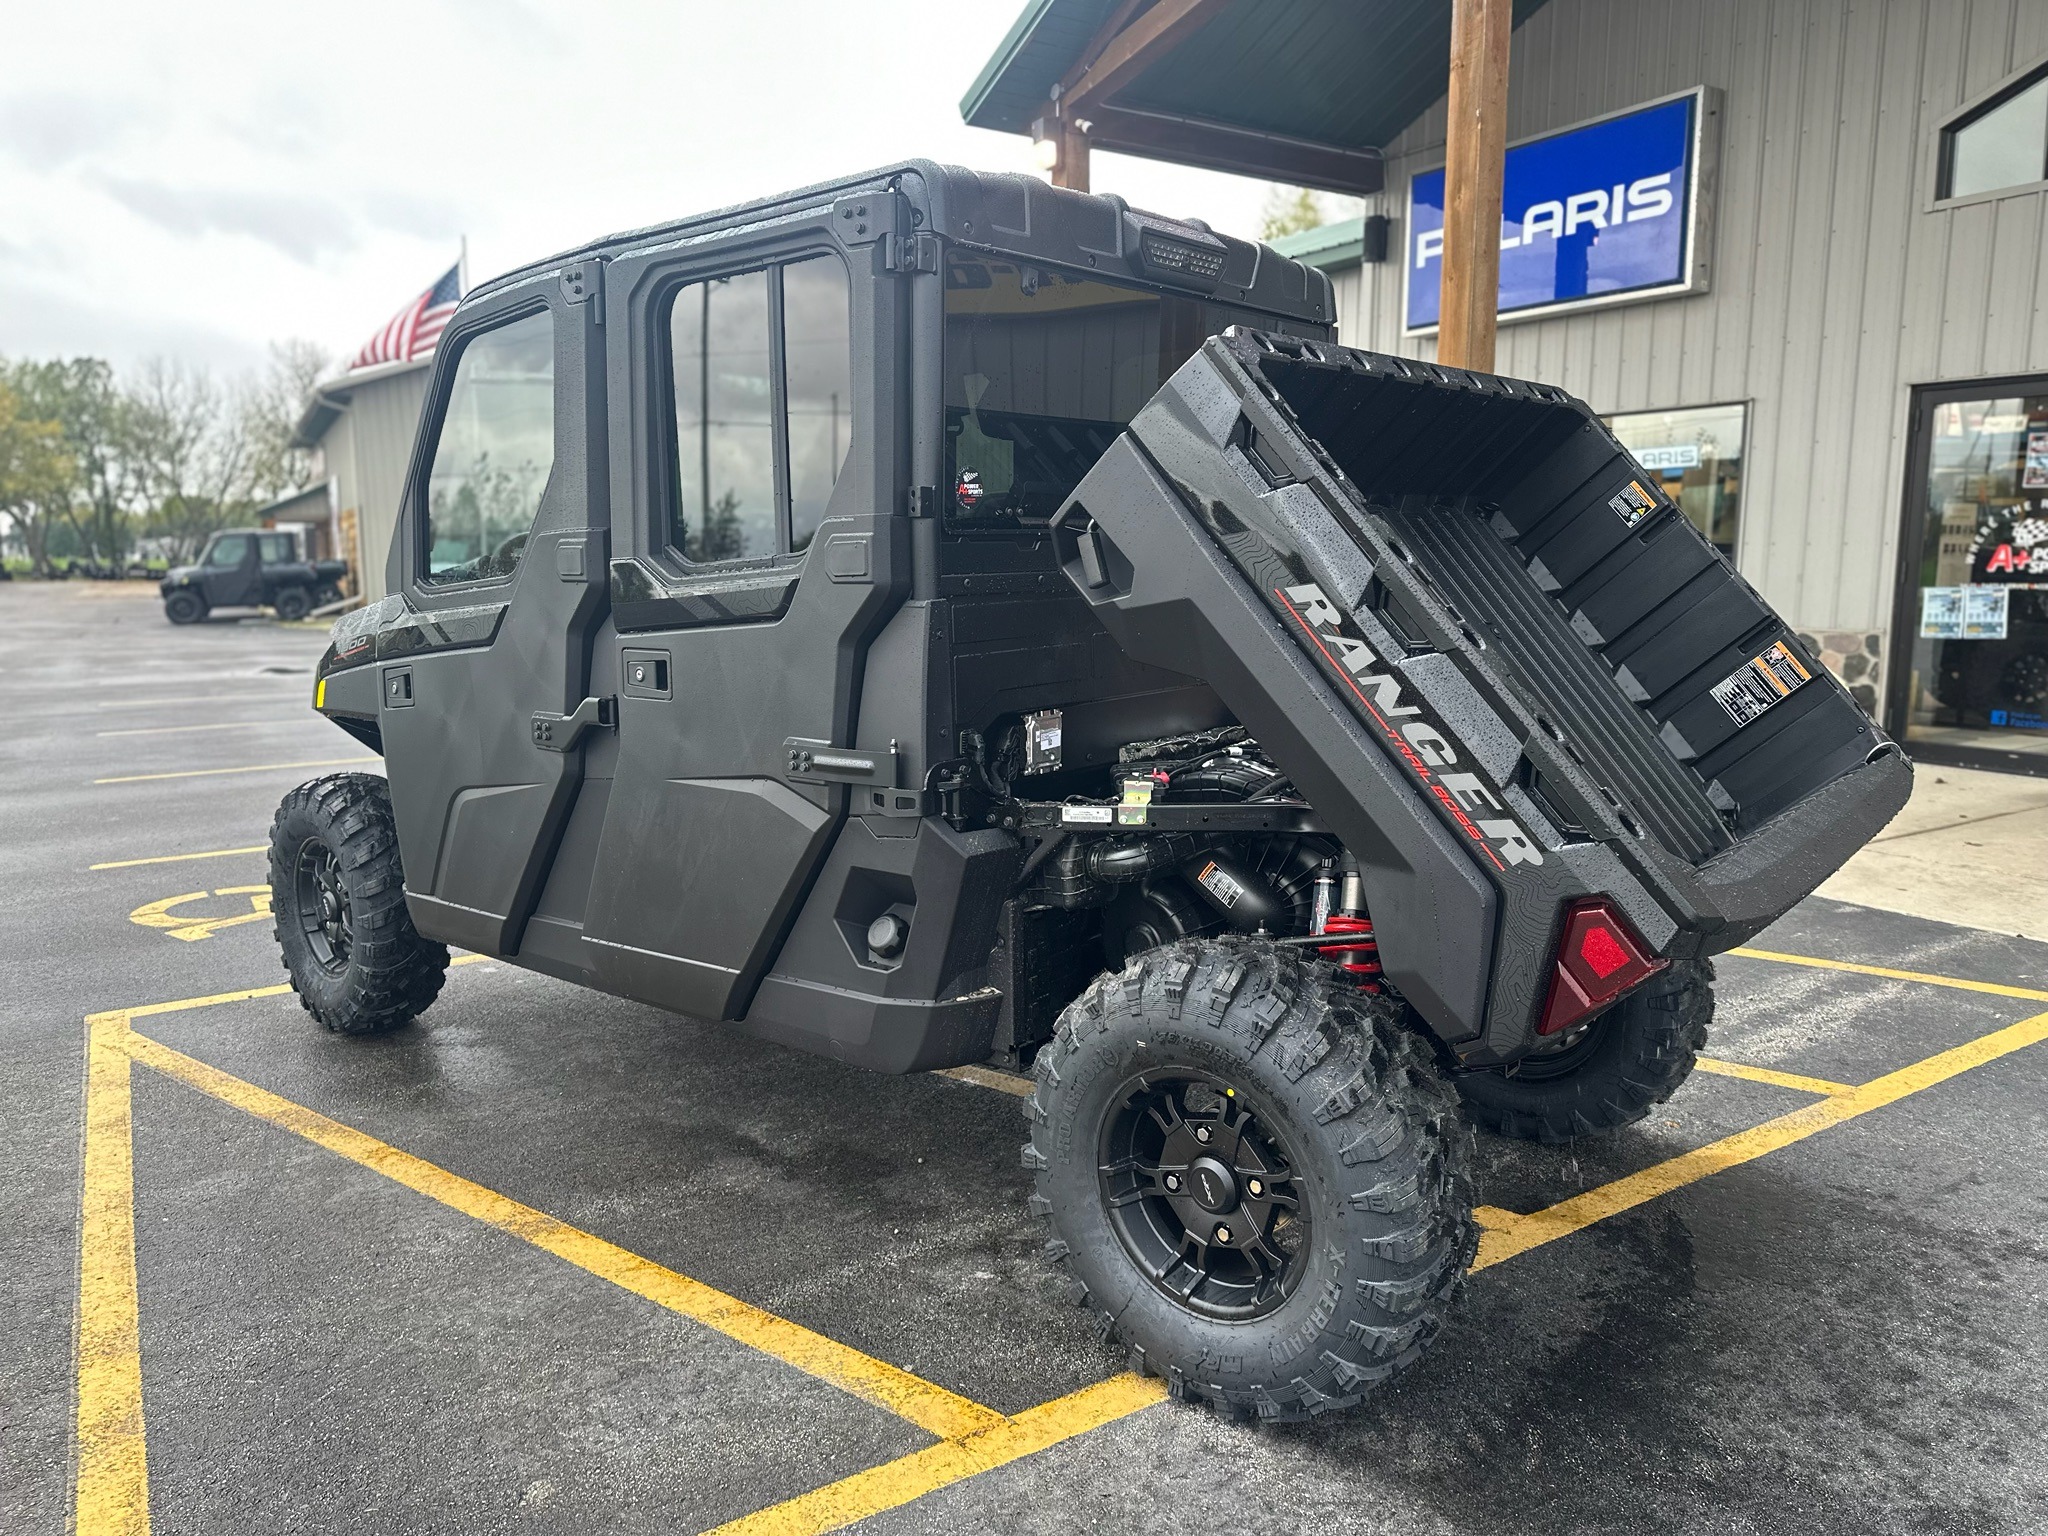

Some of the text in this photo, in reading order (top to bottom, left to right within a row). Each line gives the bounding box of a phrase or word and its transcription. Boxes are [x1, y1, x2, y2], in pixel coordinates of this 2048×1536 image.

[1416, 173, 1673, 269] PLARIS
[1642, 449, 1695, 466] ARIS
[1985, 543, 2031, 573] A+
[2001, 501, 2032, 519] THE
[1285, 583, 1544, 866] RANGER
[1388, 728, 1484, 841] TRAIL BOSS
[1269, 1240, 1348, 1368] X-TERRAIN
